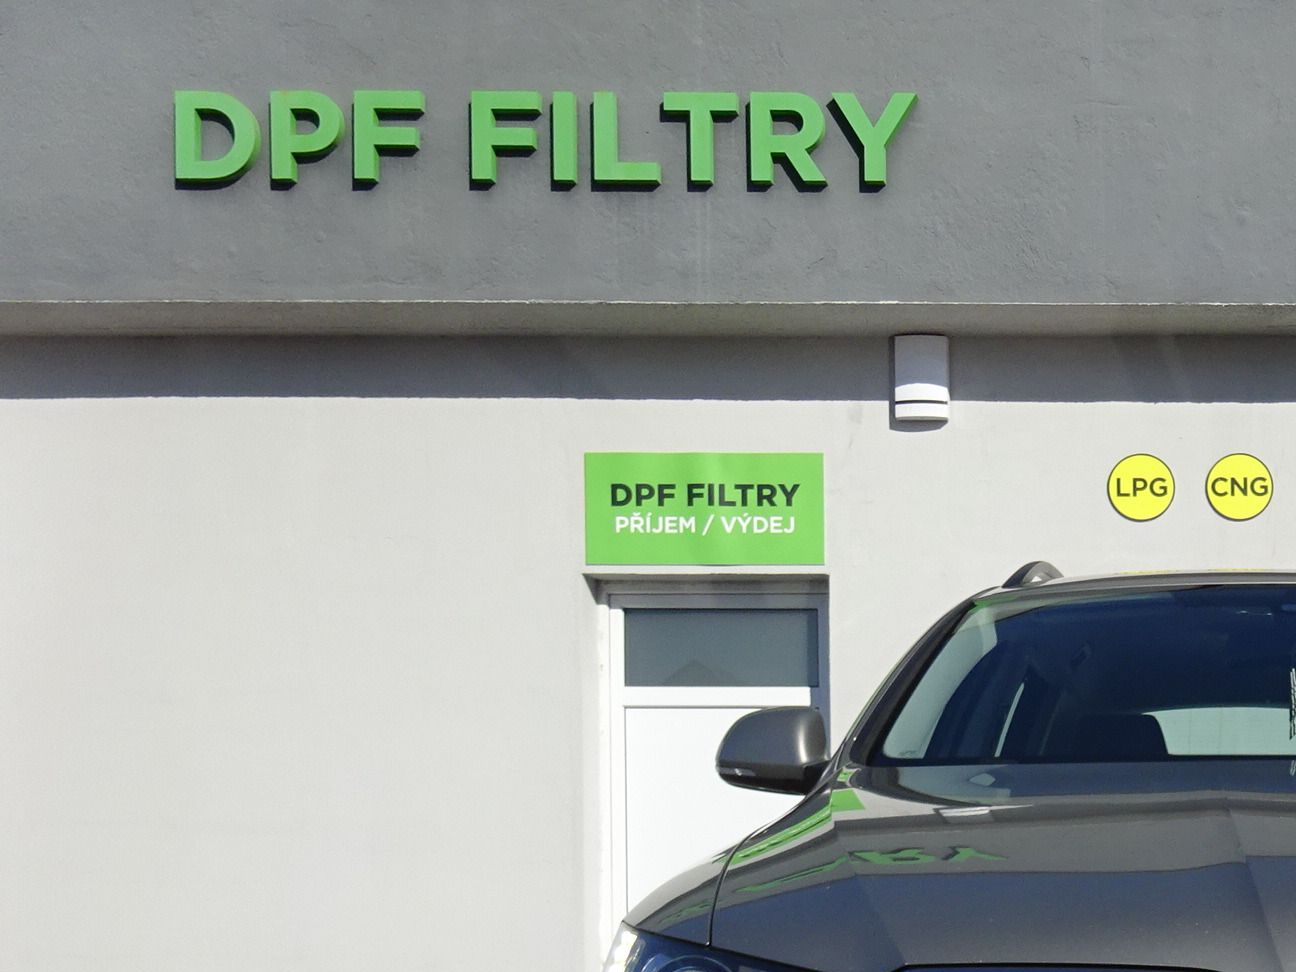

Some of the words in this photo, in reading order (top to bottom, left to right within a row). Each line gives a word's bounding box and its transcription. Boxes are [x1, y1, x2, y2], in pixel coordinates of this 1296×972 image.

[174, 90, 426, 185] DPF
[469, 90, 918, 187] FILTRY
[610, 483, 676, 507] DPF
[686, 483, 800, 507] FILTRY
[1116, 477, 1168, 497] LPG
[1211, 477, 1269, 497] CNG
[615, 512, 696, 533] PŘÍJEM
[702, 514, 715, 536] /
[721, 512, 796, 533] VÝDEJ
